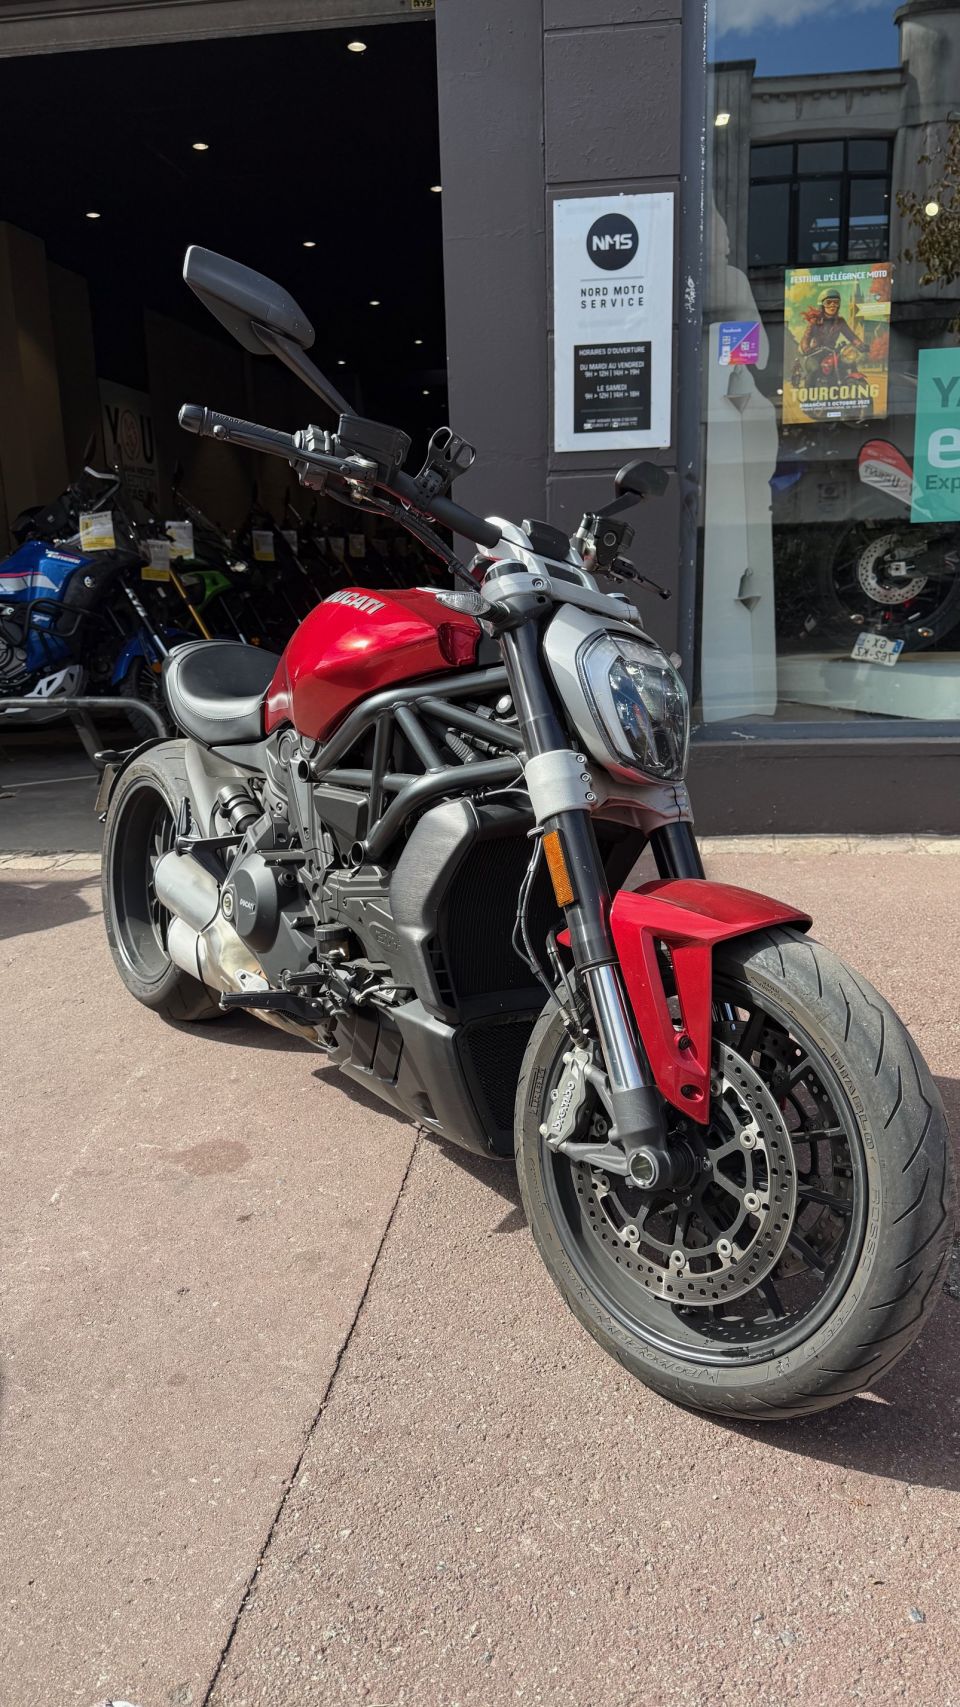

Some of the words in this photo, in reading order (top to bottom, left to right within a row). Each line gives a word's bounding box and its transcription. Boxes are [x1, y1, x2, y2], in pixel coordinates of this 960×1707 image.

[592, 233, 633, 251] NMS
[790, 274, 822, 284] FESTIVAL
[823, 271, 865, 282] D'ÉLÉGANCE
[866, 269, 888, 279] MOTO
[580, 287, 608, 297] NORD
[613, 285, 645, 295] MOTO
[580, 297, 645, 309] SERVICE
[579, 348, 606, 356] HORAIRES
[607, 346, 646, 355] D'OUVERTURE
[589, 362, 608, 370] MARDI
[790, 383, 880, 402] TOURCOING
[323, 590, 386, 615] DUCATI
[553, 1081, 576, 1132] brembo
